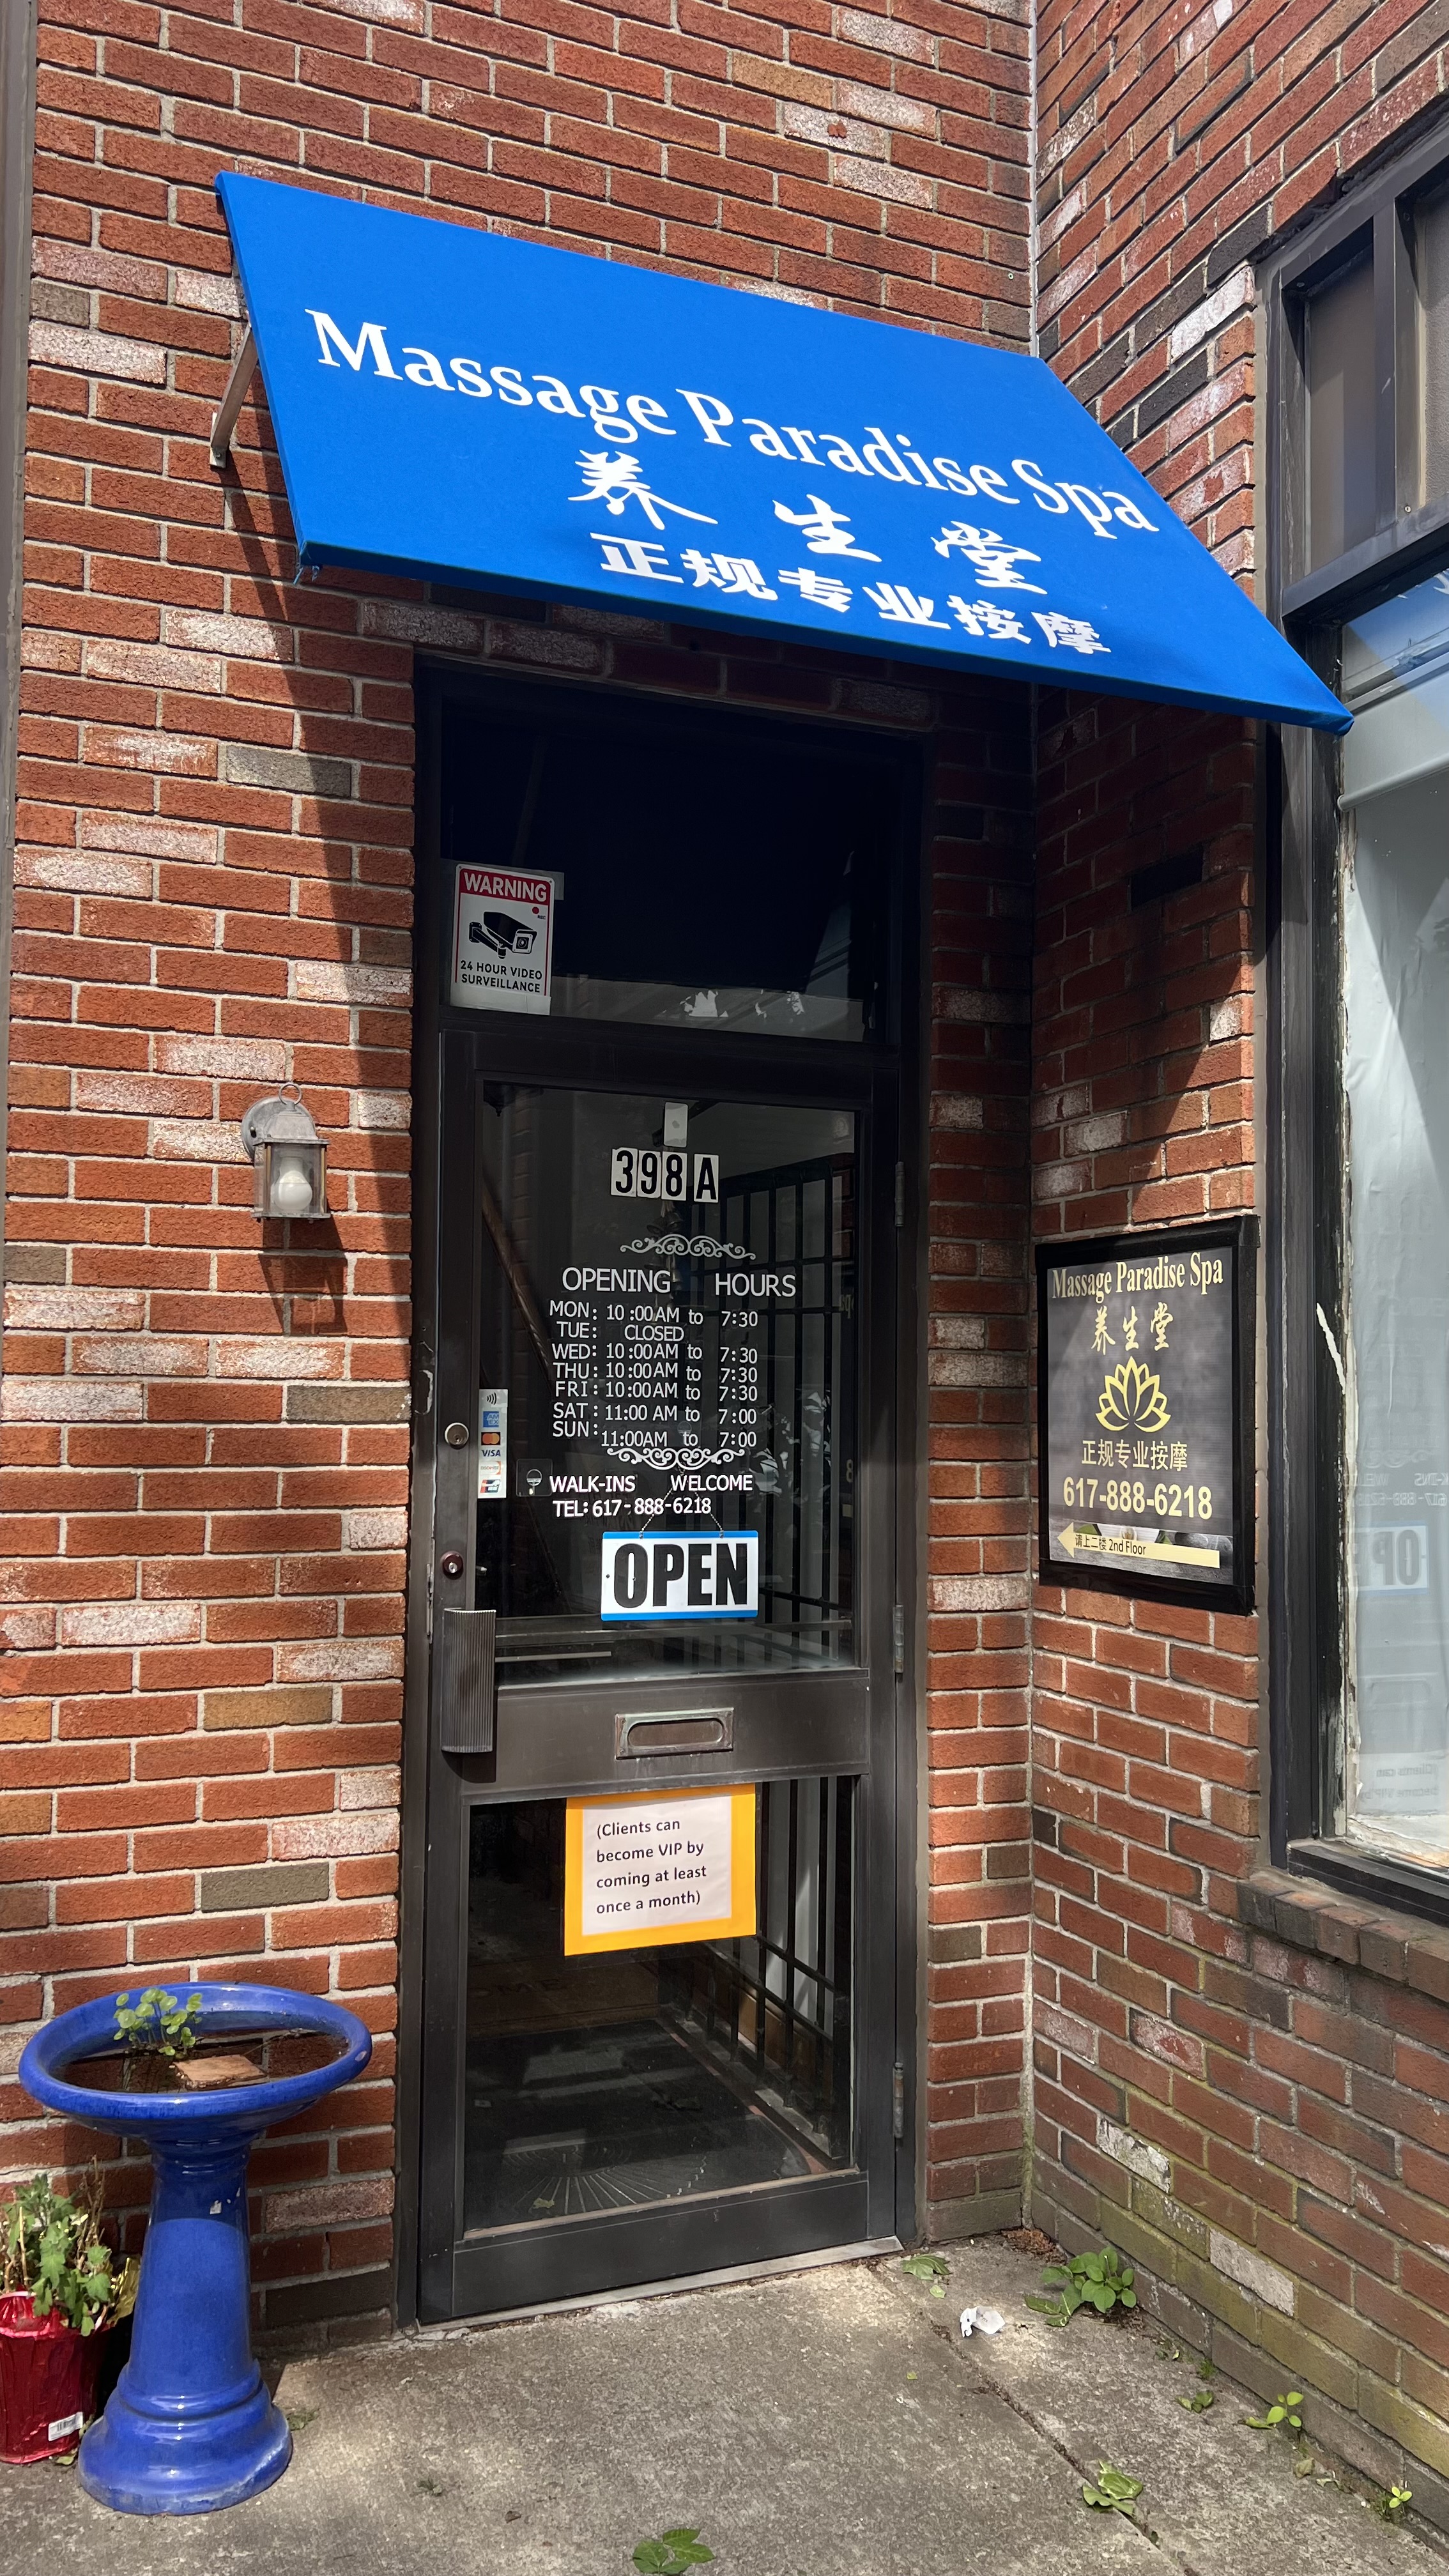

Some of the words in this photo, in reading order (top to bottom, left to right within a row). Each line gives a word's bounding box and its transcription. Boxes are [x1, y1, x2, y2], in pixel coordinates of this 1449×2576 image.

[305, 309, 677, 443] Massage
[675, 388, 1020, 505] Paradise
[1011, 459, 1160, 540] Spa
[568, 449, 1048, 595] 养生堂
[590, 532, 1112, 655] 正规专业按摩
[463, 871, 548, 903] WARNING
[460, 960, 473, 971] 24
[477, 962, 507, 976] HOUR
[510, 967, 543, 981] VIDEO
[461, 974, 540, 993] SURVEILLANCE
[562, 1267, 671, 1294] OPENING
[716, 1273, 797, 1298] HOURS
[1052, 1269, 1112, 1304] Massage
[1116, 1255, 1185, 1293] Paradise
[1190, 1252, 1223, 1295] Spa
[549, 1300, 597, 1321] MON:
[688, 1308, 704, 1325] to
[721, 1310, 759, 1328] 7:30
[556, 1321, 597, 1339] TUE:
[624, 1324, 685, 1342] CLOSED
[1091, 1301, 1174, 1355] 养生堂
[552, 1343, 597, 1360] WED:
[687, 1344, 703, 1360] to
[720, 1346, 758, 1364] 7:30
[553, 1362, 598, 1379] THU:
[686, 1366, 702, 1381] to
[720, 1367, 758, 1383] 7:30
[555, 1381, 598, 1398] FRI:
[686, 1384, 701, 1400] to
[719, 1385, 758, 1402] 7:30
[553, 1402, 598, 1419] SAT:
[605, 1404, 648, 1422] 11:00
[652, 1405, 677, 1422] AM
[685, 1406, 700, 1422] to
[718, 1408, 757, 1425] 7:00
[552, 1420, 598, 1438] SUN:
[683, 1431, 698, 1446] to
[719, 1431, 757, 1448] 7:00
[1082, 1439, 1188, 1472] 正规专业按摩
[549, 1475, 636, 1492] WALK-INS
[671, 1475, 753, 1491] WELCOME
[1063, 1476, 1213, 1520] 617-888-6218
[1075, 1533, 1107, 1551] 请上二楼
[1108, 1539, 1124, 1552] 2nd
[1126, 1540, 1146, 1555] Floor
[614, 1543, 747, 1609] OPEN
[597, 1821, 652, 1839] (Clients
[656, 1821, 680, 1831] can
[597, 1848, 654, 1862] become
[658, 1843, 682, 1856] VIP
[687, 1841, 704, 1856] by
[596, 1873, 650, 1888] coming
[656, 1871, 669, 1882] at
[674, 1866, 707, 1880] least
[596, 1901, 631, 1914] once
[636, 1900, 644, 1910] a
[648, 1890, 701, 1908] month)
